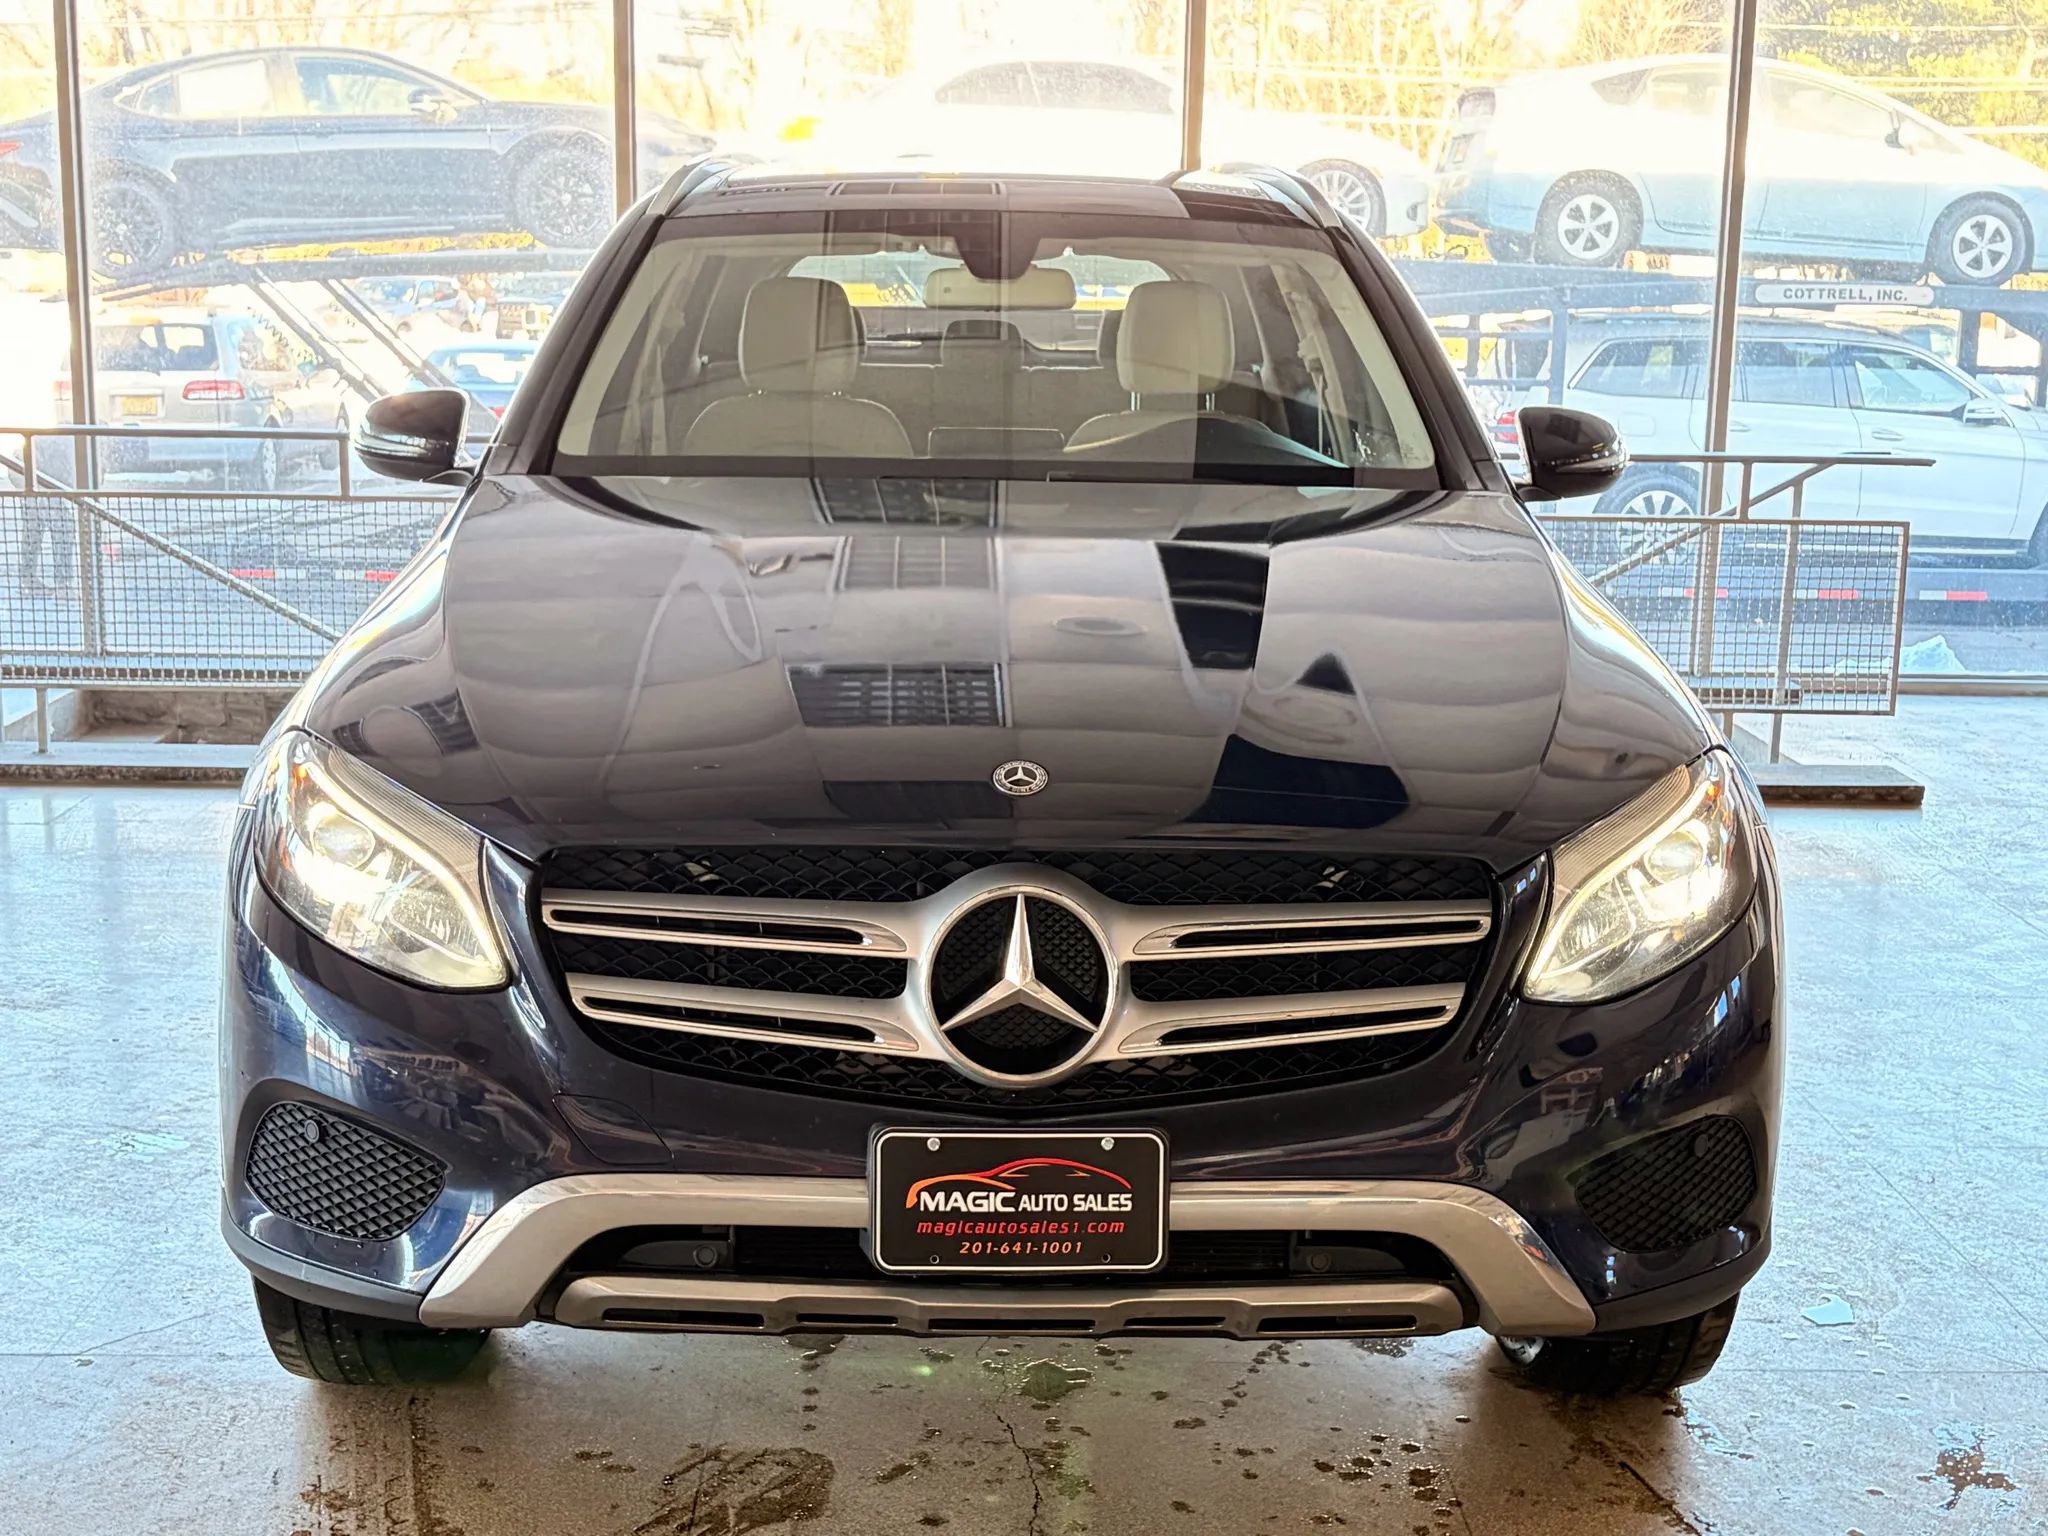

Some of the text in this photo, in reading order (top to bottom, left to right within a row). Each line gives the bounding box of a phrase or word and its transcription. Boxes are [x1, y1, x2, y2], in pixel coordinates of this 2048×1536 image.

[1783, 288, 1908, 302] COTTRELL, INC.
[919, 1191, 1133, 1213] MAGIC AUTO SALES
[916, 1220, 1125, 1237] magicautosales1.com
[959, 1241, 1082, 1254] 201-641-1001
